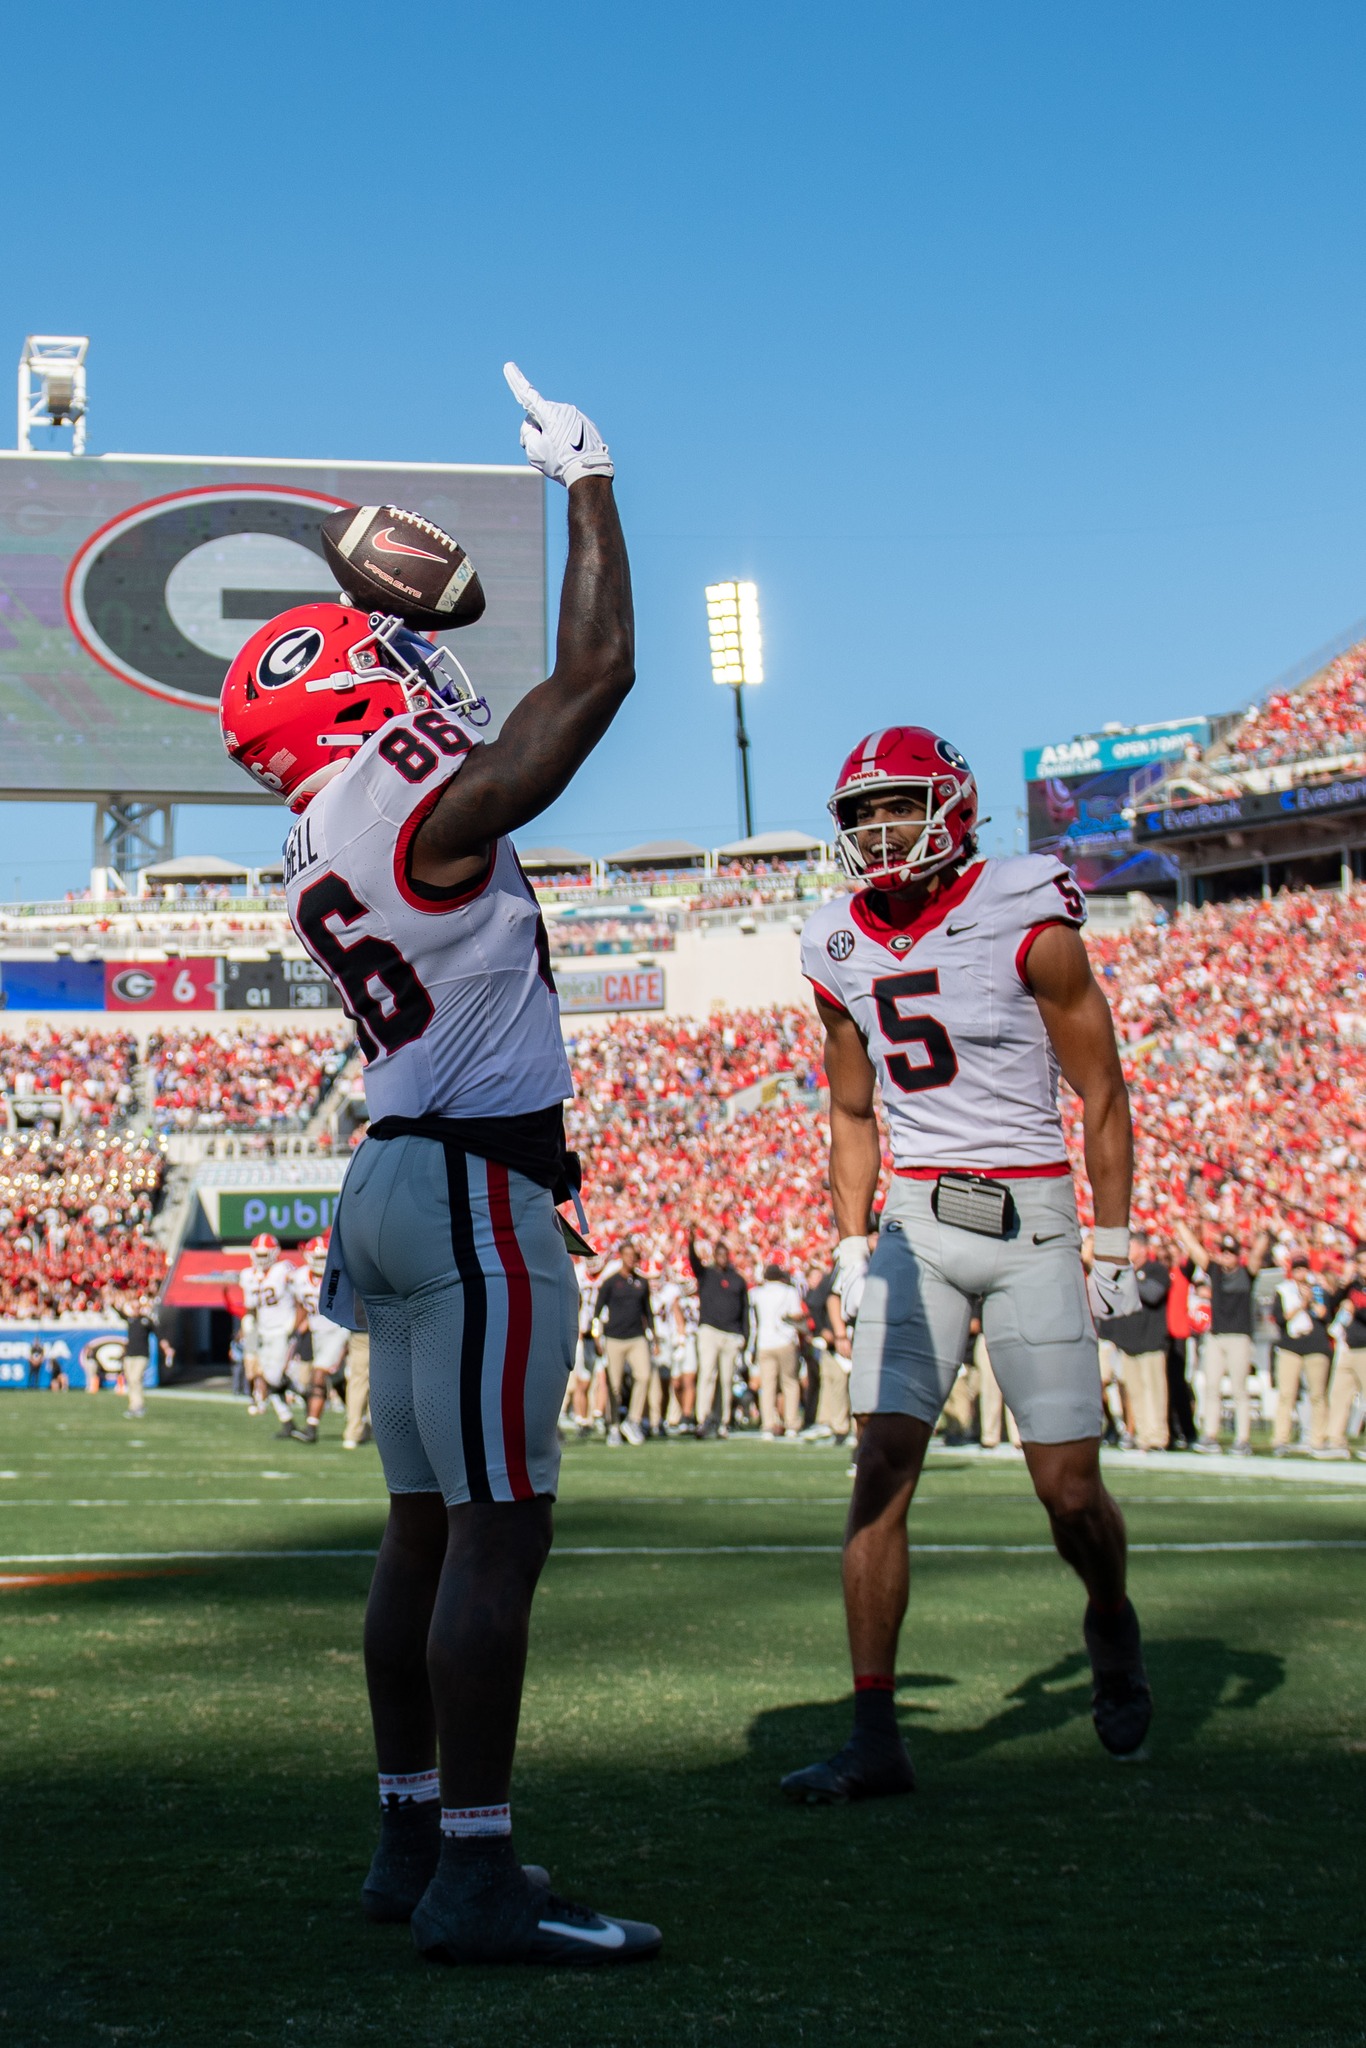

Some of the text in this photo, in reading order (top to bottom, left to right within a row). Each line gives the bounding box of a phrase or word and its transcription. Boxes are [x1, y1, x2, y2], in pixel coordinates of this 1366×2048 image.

[364, 560, 392, 584] VAPOR
[393, 577, 423, 599] ELITE
[257, 628, 322, 687] G
[379, 709, 473, 784] 86
[1040, 740, 1099, 765] ASAP
[1112, 741, 1149, 760] OPEN
[251, 762, 283, 790] 6
[850, 770, 880, 782] DAWGS
[1163, 800, 1242, 831] EverBank
[1053, 871, 1085, 919] 5
[827, 930, 855, 962] SEC
[890, 936, 913, 951] G
[290, 871, 435, 1067] 6
[115, 970, 155, 1000] G
[172, 969, 196, 1003] 6
[604, 972, 659, 1004] CAFE
[872, 968, 959, 1094] 5
